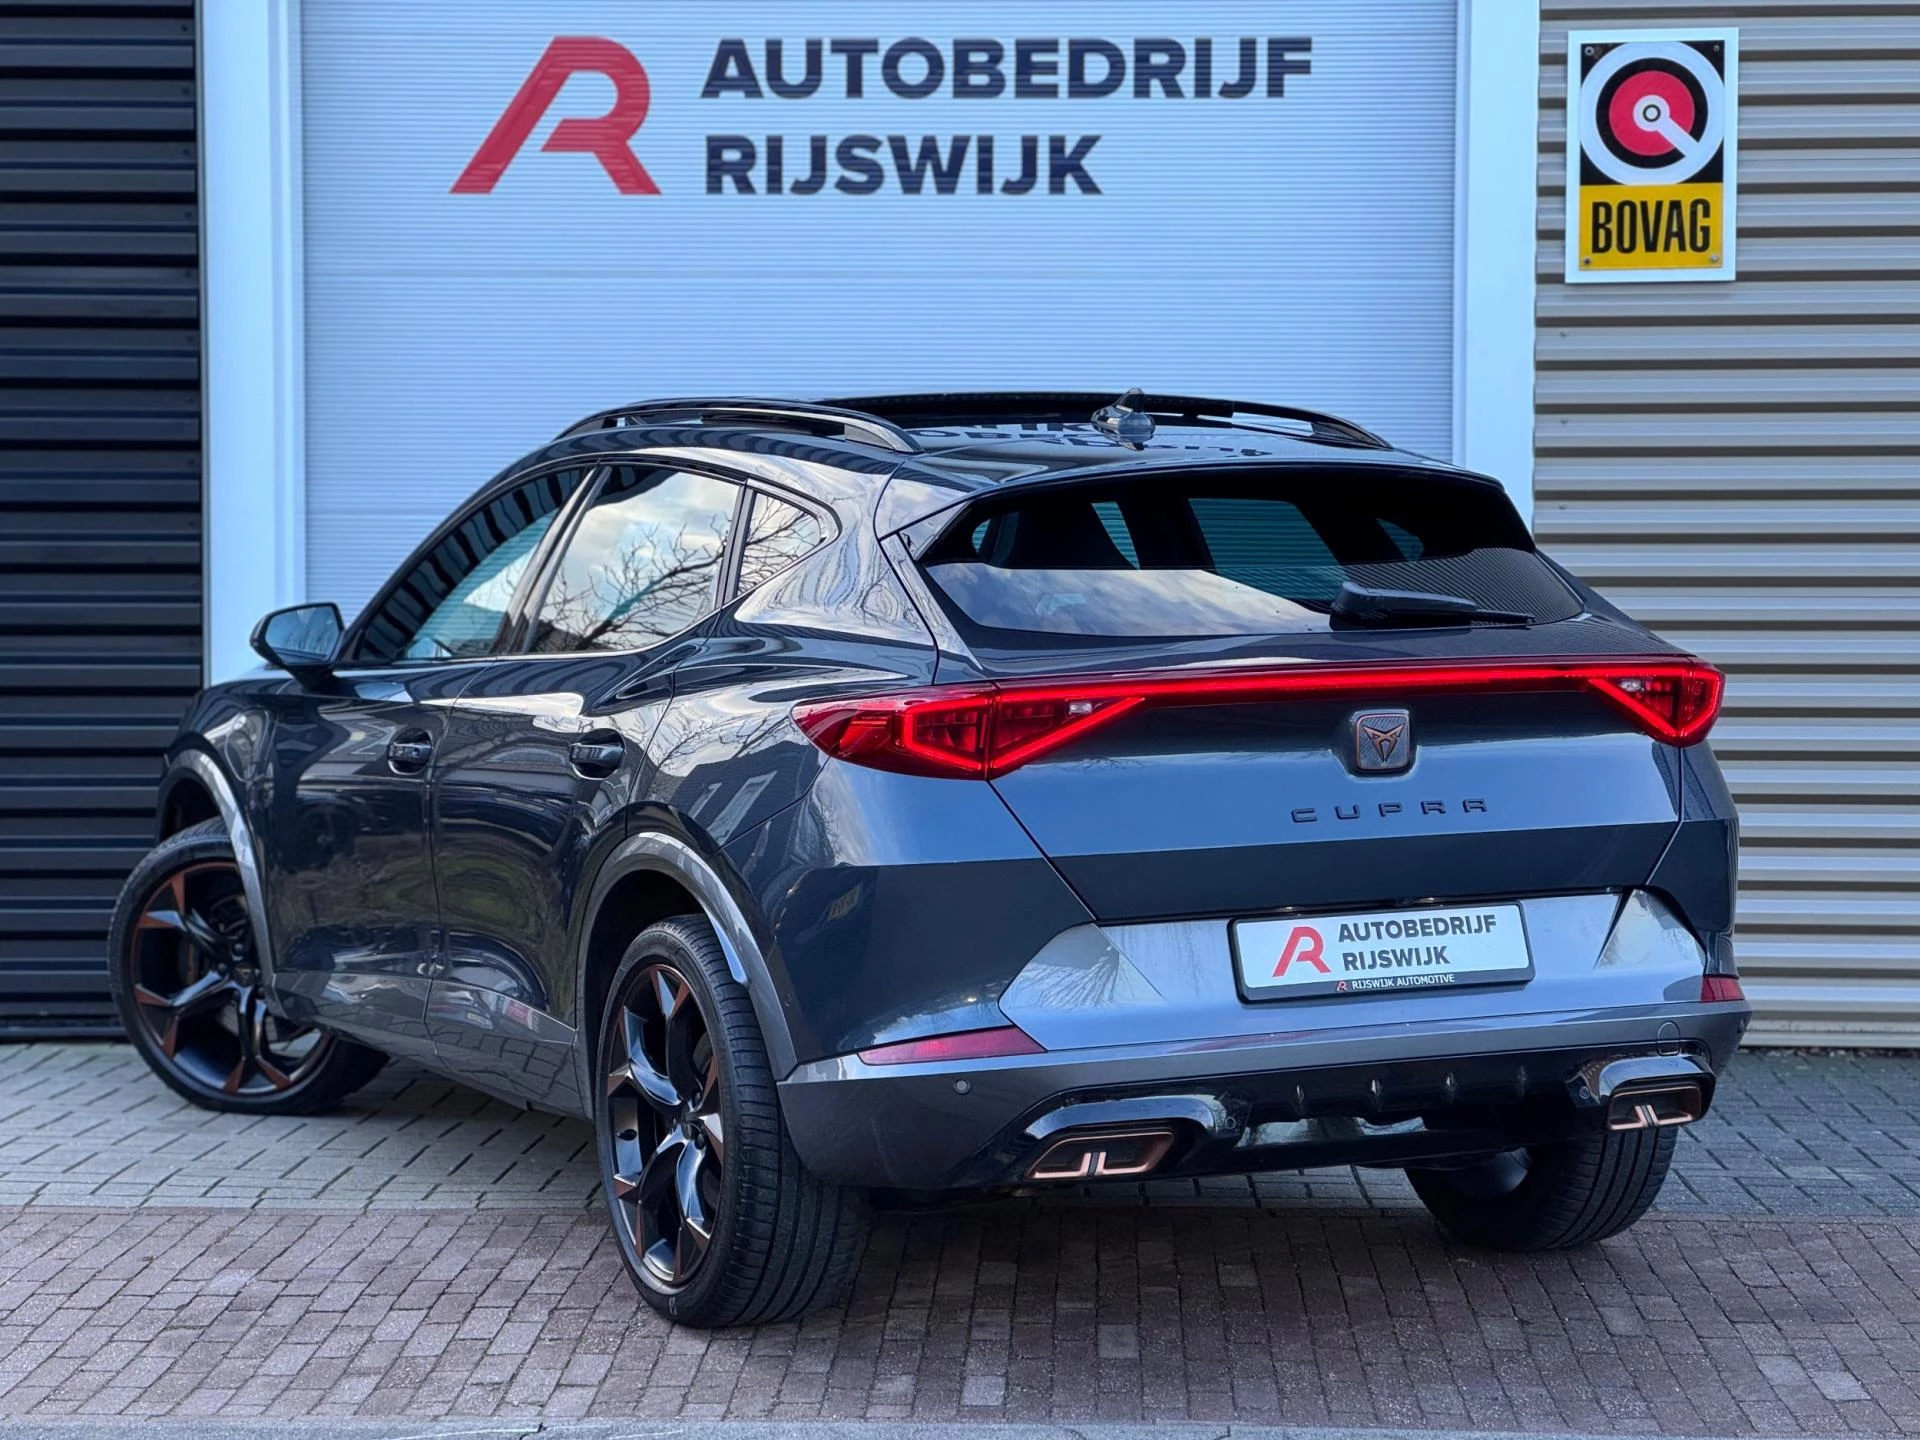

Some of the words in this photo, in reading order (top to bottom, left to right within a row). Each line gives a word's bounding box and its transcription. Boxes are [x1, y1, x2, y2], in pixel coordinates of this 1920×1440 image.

[701, 37, 1313, 99] AUTOBEDRIJF
[705, 134, 1103, 195] RIJSWIJK
[1591, 198, 1711, 254] BOVAG
[1291, 799, 1488, 824] CUPRA
[1338, 914, 1497, 943] AUTOBEDRIJF
[1342, 945, 1450, 971] RIJSWIJK
[1352, 978, 1395, 990] RIJSWIJK
[1397, 973, 1456, 986] AUTOMOTIVE
